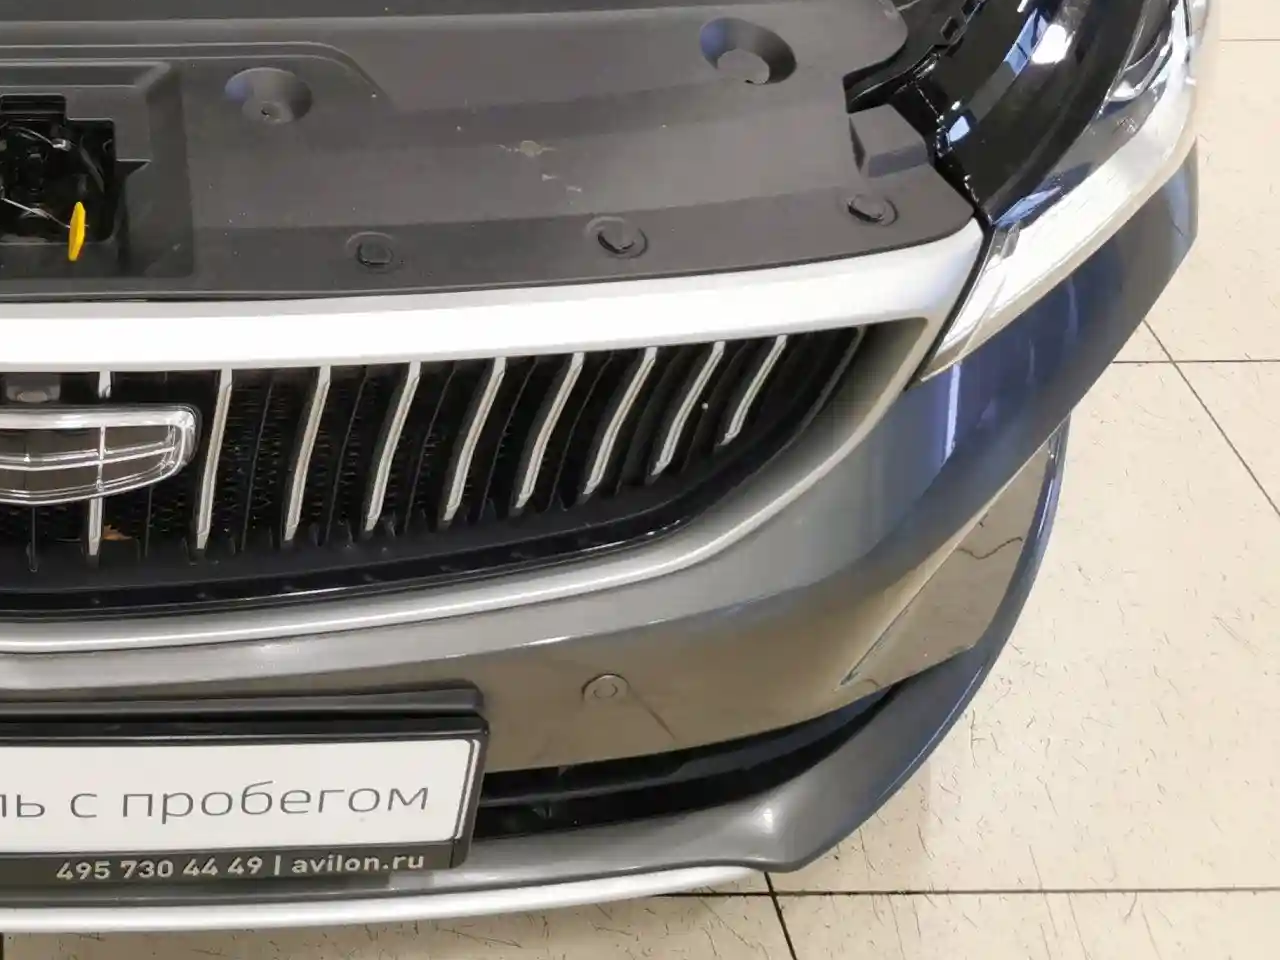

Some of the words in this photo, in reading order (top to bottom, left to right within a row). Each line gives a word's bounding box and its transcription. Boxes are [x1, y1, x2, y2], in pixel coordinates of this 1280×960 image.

[69, 792, 98, 818] с
[122, 780, 430, 824] пробегом
[56, 860, 111, 880] 495
[120, 859, 174, 879] 730
[183, 857, 219, 877] 44
[227, 855, 263, 875] 49
[291, 854, 425, 874] avilon.ru
